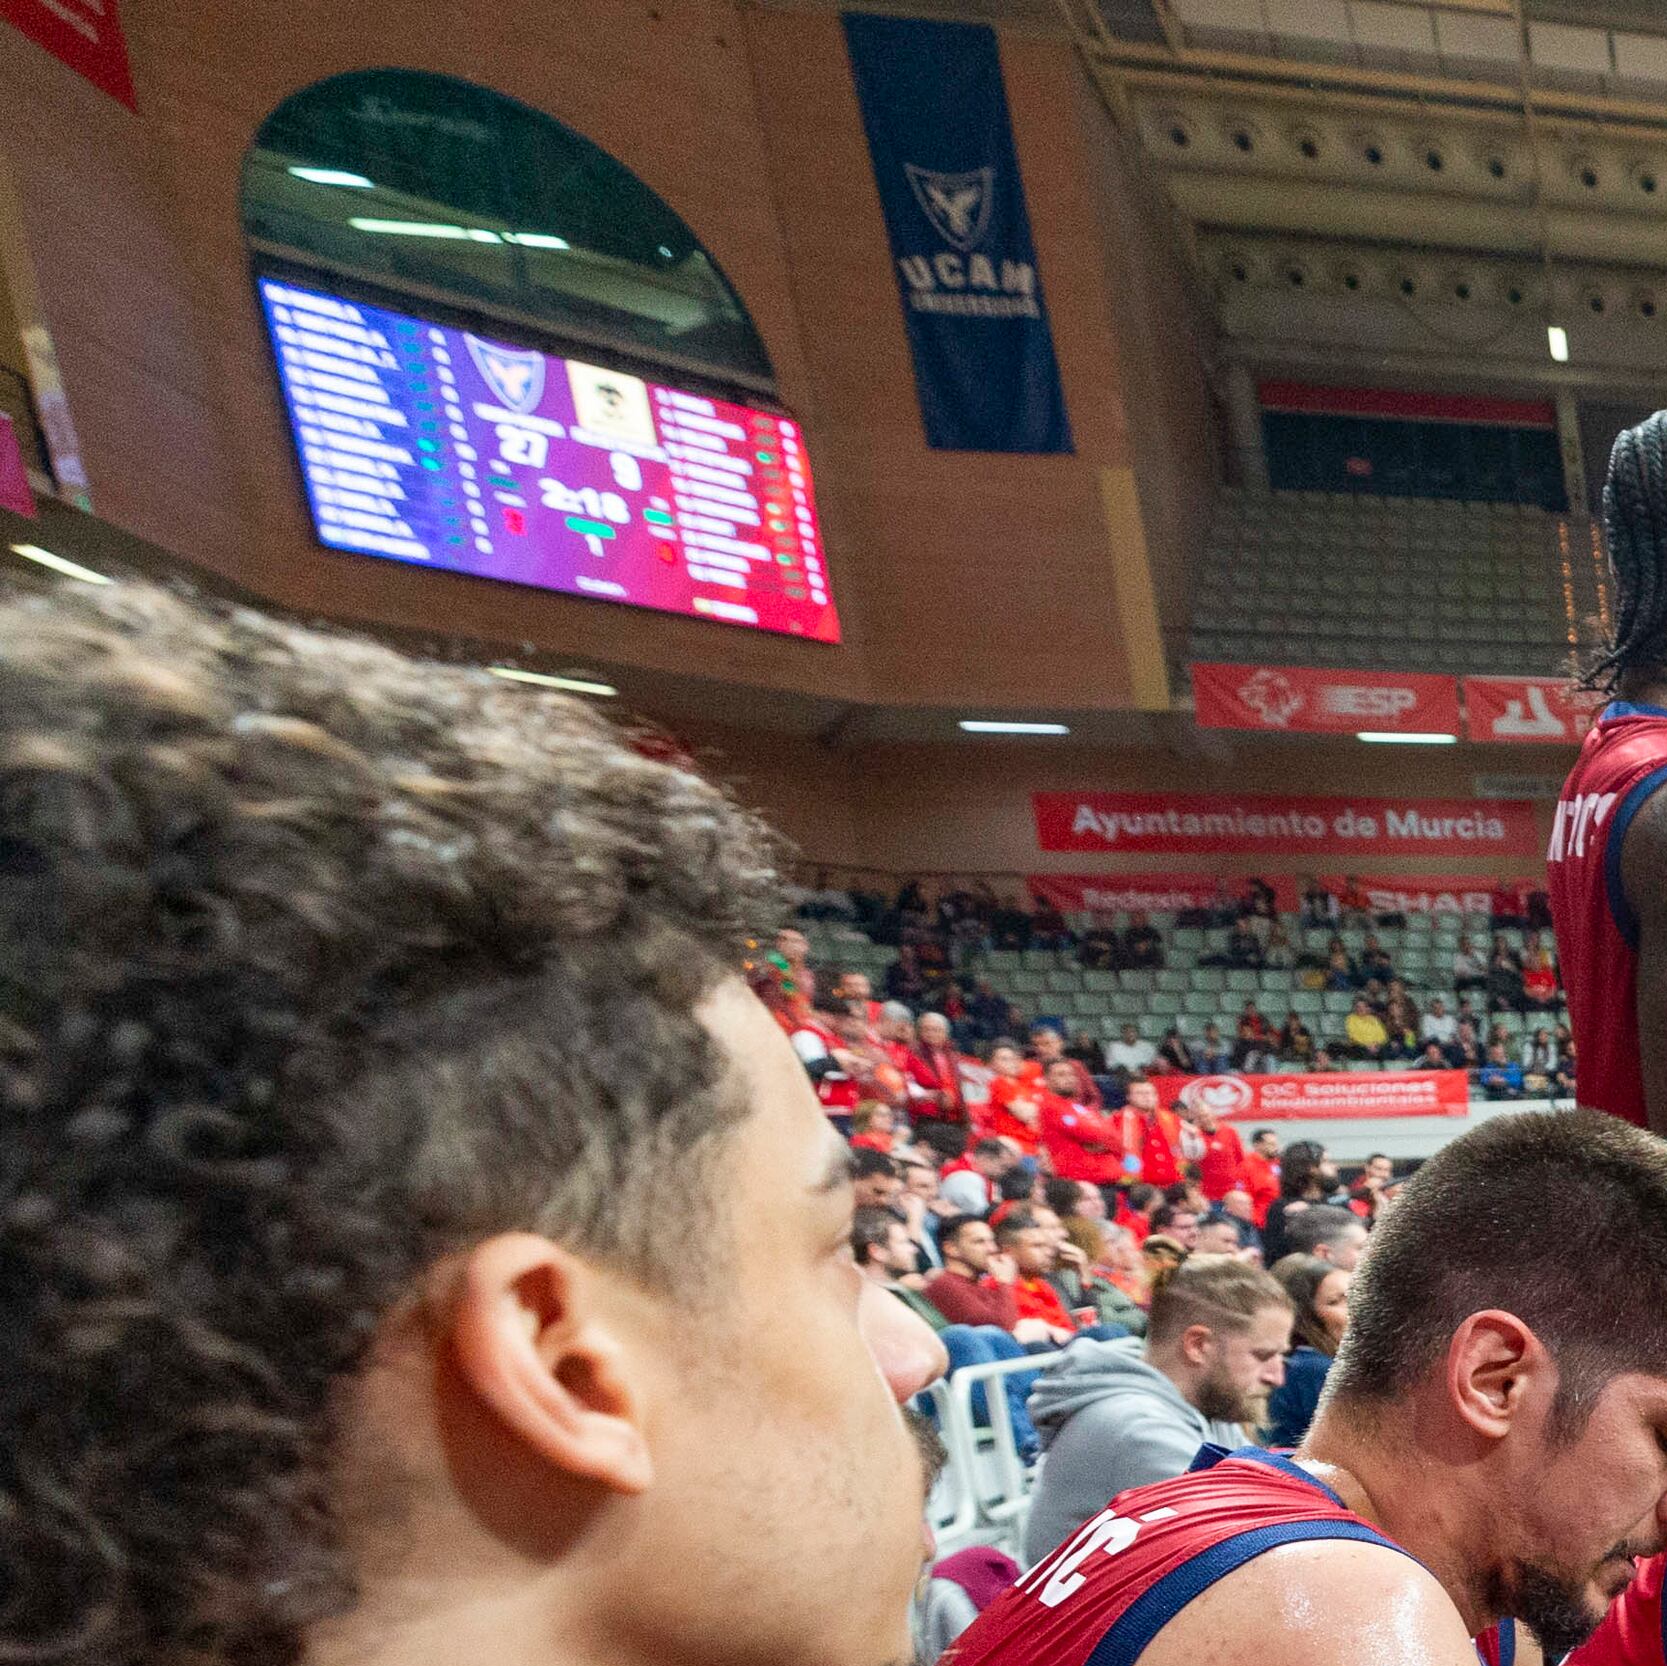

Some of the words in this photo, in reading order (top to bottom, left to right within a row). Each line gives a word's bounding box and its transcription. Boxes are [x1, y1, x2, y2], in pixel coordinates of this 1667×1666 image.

[900, 253, 1033, 295] UCAM
[1073, 804, 1326, 841] Ayuntamiento
[1333, 806, 1379, 839] de
[1385, 809, 1504, 841] Murcia
